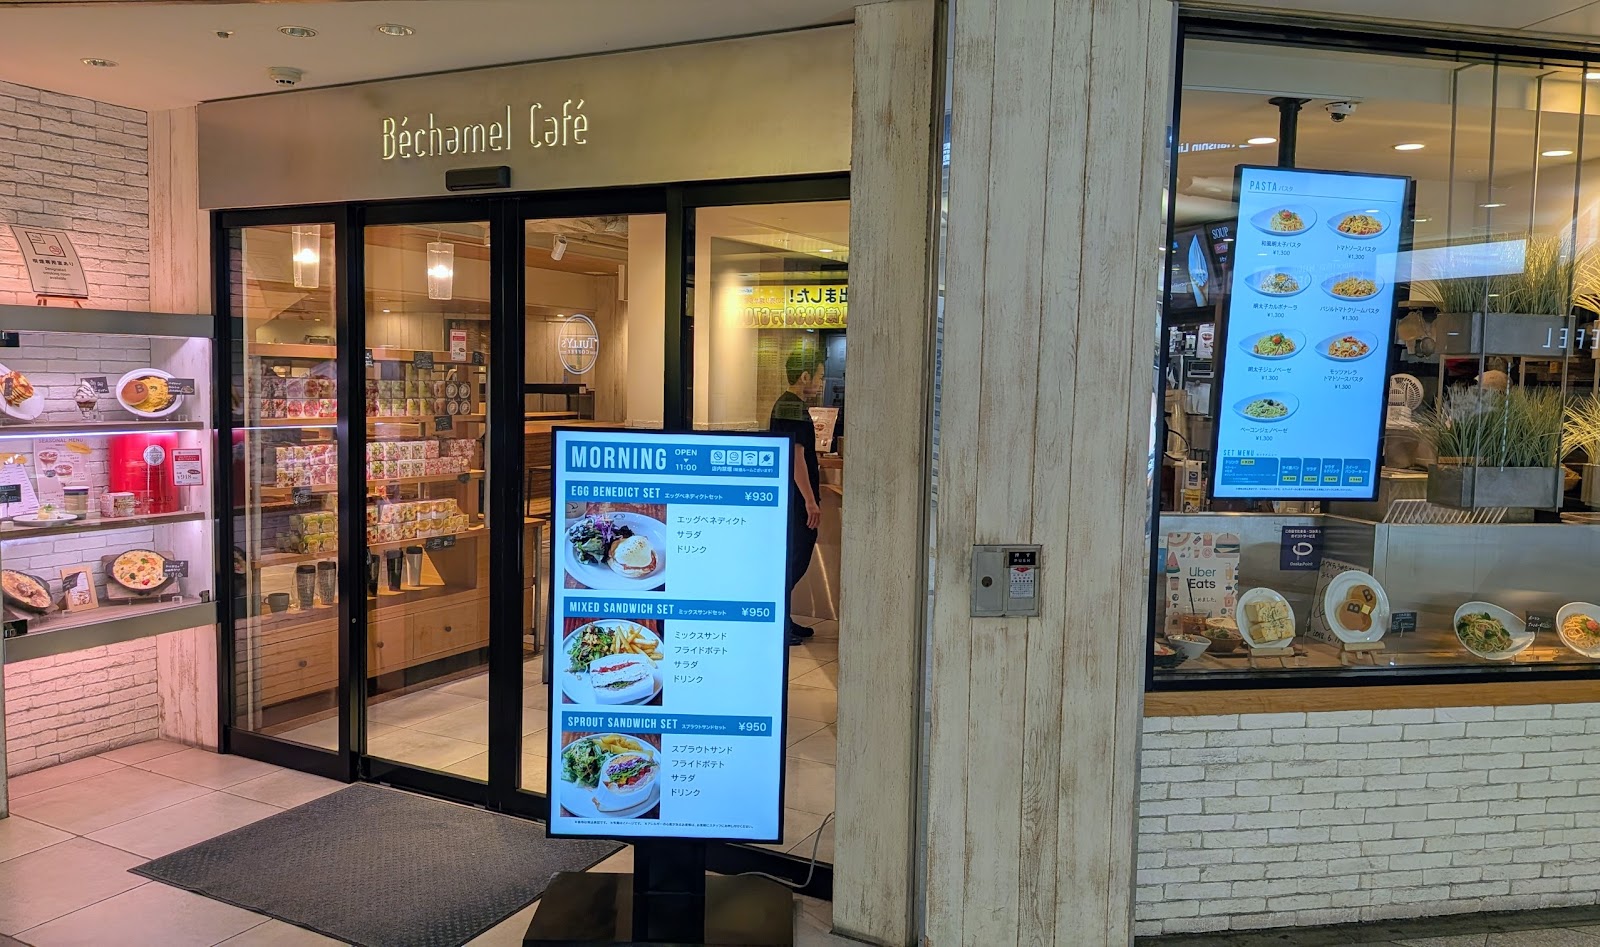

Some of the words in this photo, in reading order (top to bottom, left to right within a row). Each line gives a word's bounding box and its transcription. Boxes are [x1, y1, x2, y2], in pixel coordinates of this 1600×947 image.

[382, 105, 511, 160] Béchamel
[530, 99, 588, 148] Café
[1250, 180, 1277, 191] PASTA
[1212, 226, 1228, 239] SOUP
[135, 383, 145, 394] B
[571, 446, 667, 470] MORNING
[675, 463, 697, 471] 11:00
[571, 486, 589, 497] EGG
[593, 486, 640, 498] BENEDICT
[643, 488, 661, 499] SET
[744, 492, 773, 502] ¥930
[677, 516, 746, 525] エッグベネディクト
[677, 530, 702, 539] サラダ
[677, 545, 707, 554] ドリンク
[1190, 567, 1216, 577] Uber
[1190, 579, 1216, 588] Eats
[1362, 589, 1373, 602] B
[570, 602, 600, 613] MIXED
[604, 602, 653, 614] SANDWICH
[657, 604, 674, 615] SET
[742, 607, 770, 617] ¥950
[1347, 603, 1360, 613] B
[674, 631, 727, 640] ミックスサンド
[674, 646, 728, 654] フライドポテト
[674, 660, 698, 669] サラダ
[674, 675, 703, 683] ドリンク
[568, 716, 604, 728] SPROUT
[608, 717, 657, 729] SANDWICH
[661, 719, 678, 729] SET
[738, 722, 767, 732] ¥950
[672, 745, 732, 754] スプラウトサンド
[672, 760, 725, 768] フライドポテト
[671, 774, 695, 782] サラダ
[671, 788, 701, 797] ドリンク
